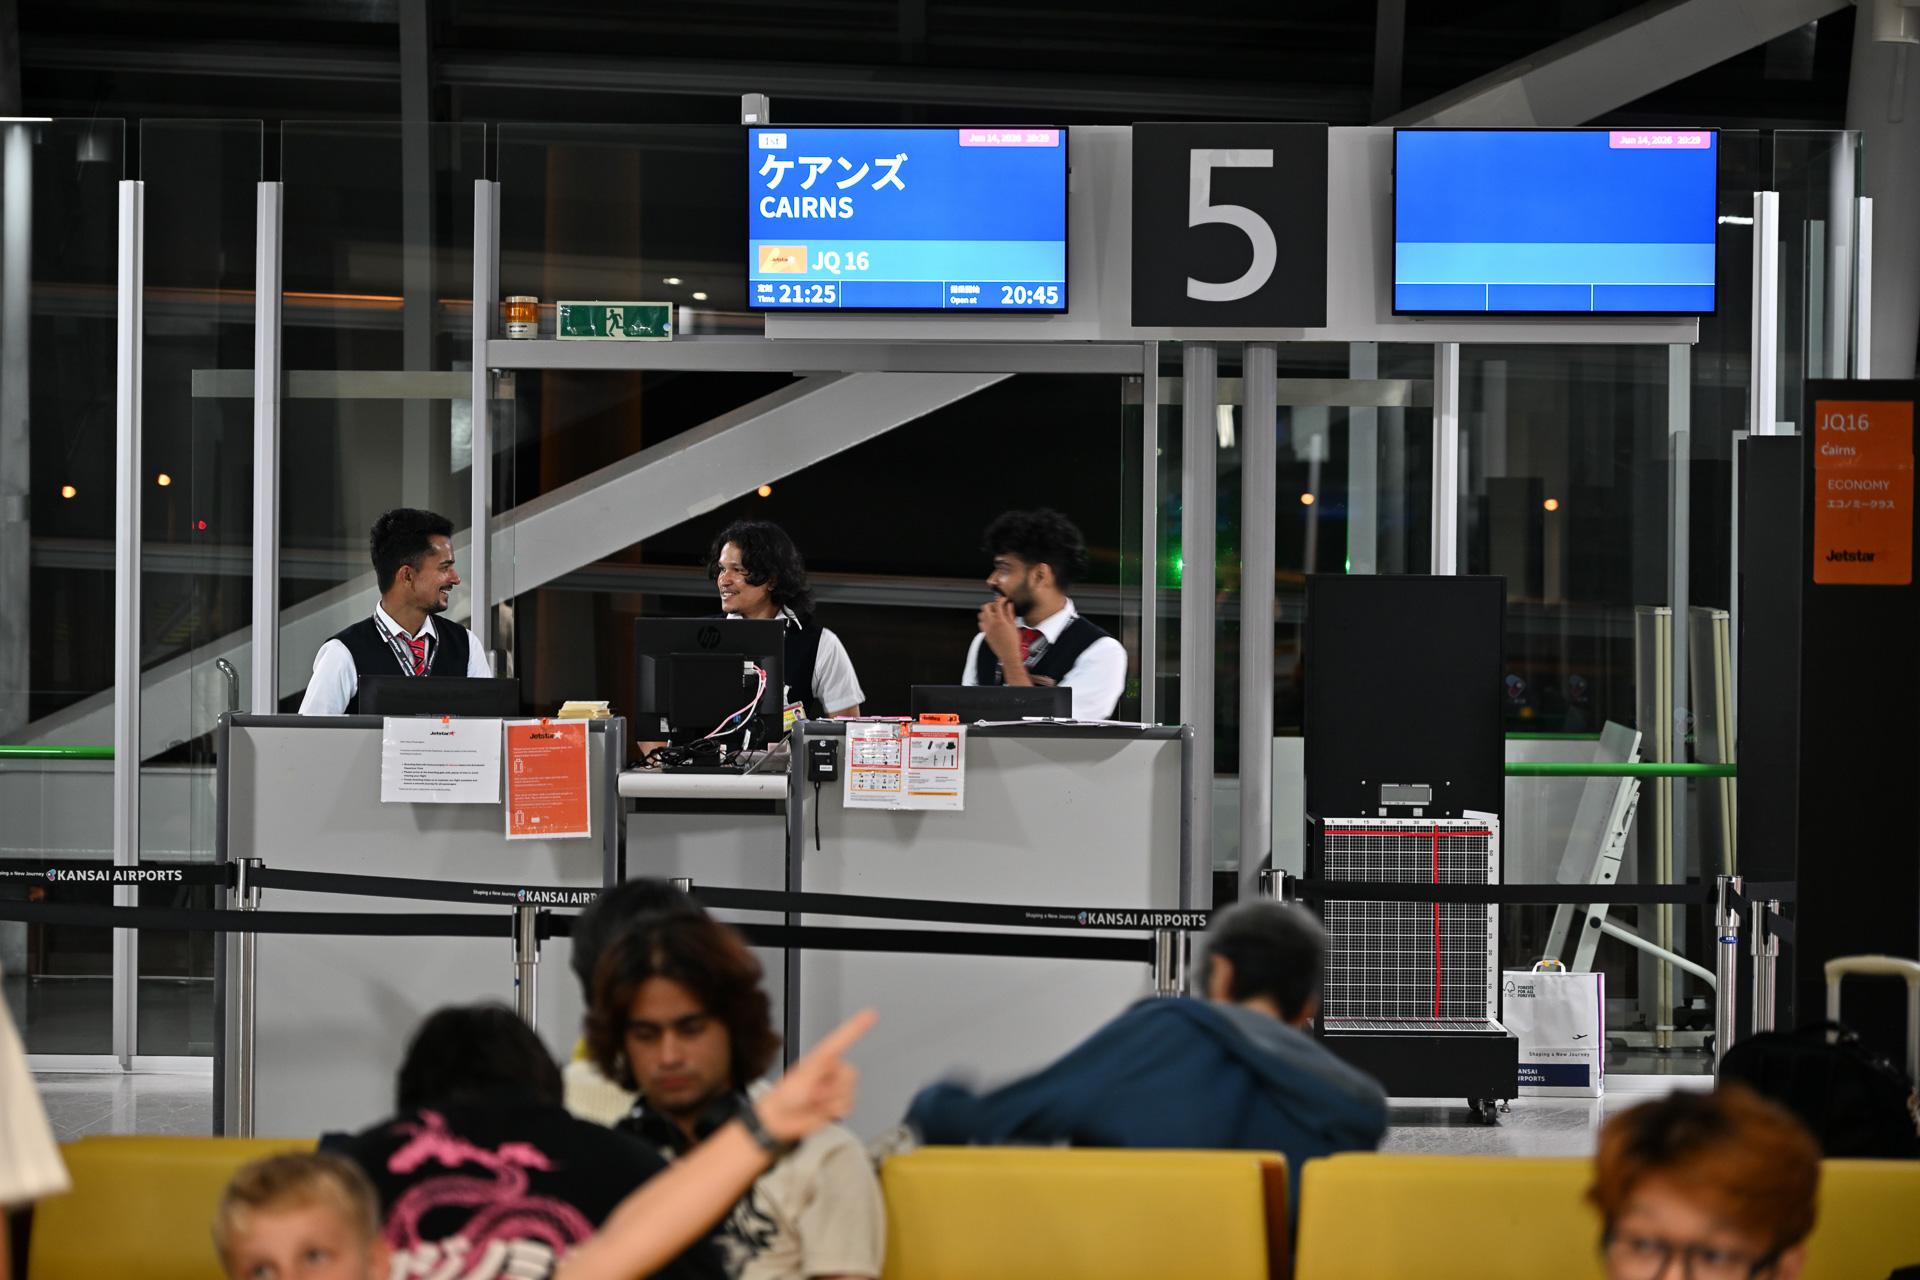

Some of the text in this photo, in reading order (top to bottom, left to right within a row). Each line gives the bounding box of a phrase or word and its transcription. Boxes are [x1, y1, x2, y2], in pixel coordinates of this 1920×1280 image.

[969, 134, 985, 143] Jun
[987, 134, 1000, 145] 14,
[1620, 136, 1701, 146] Jun 14, 2026 20:29
[758, 153, 908, 191] ケアンズ
[759, 196, 854, 219] CAIRNS
[1187, 149, 1277, 302] 5
[812, 251, 869, 274] JQ 16
[757, 295, 775, 303] Time
[779, 284, 836, 303] 21:25
[1001, 286, 1059, 304] 20:45
[1821, 413, 1869, 432] JQ16
[1821, 444, 1856, 455] Cairns
[1828, 479, 1890, 490] ECONOMY
[1827, 499, 1895, 509] エコノミークラス
[1826, 550, 1875, 562] Jetstar
[700, 626, 719, 649] hp
[529, 732, 554, 740] Jetstar
[57, 870, 182, 881] KANSAI AIRPORTS
[526, 891, 568, 903] KANSAI
[1088, 912, 1206, 927] KANSAI AIRPORTS
